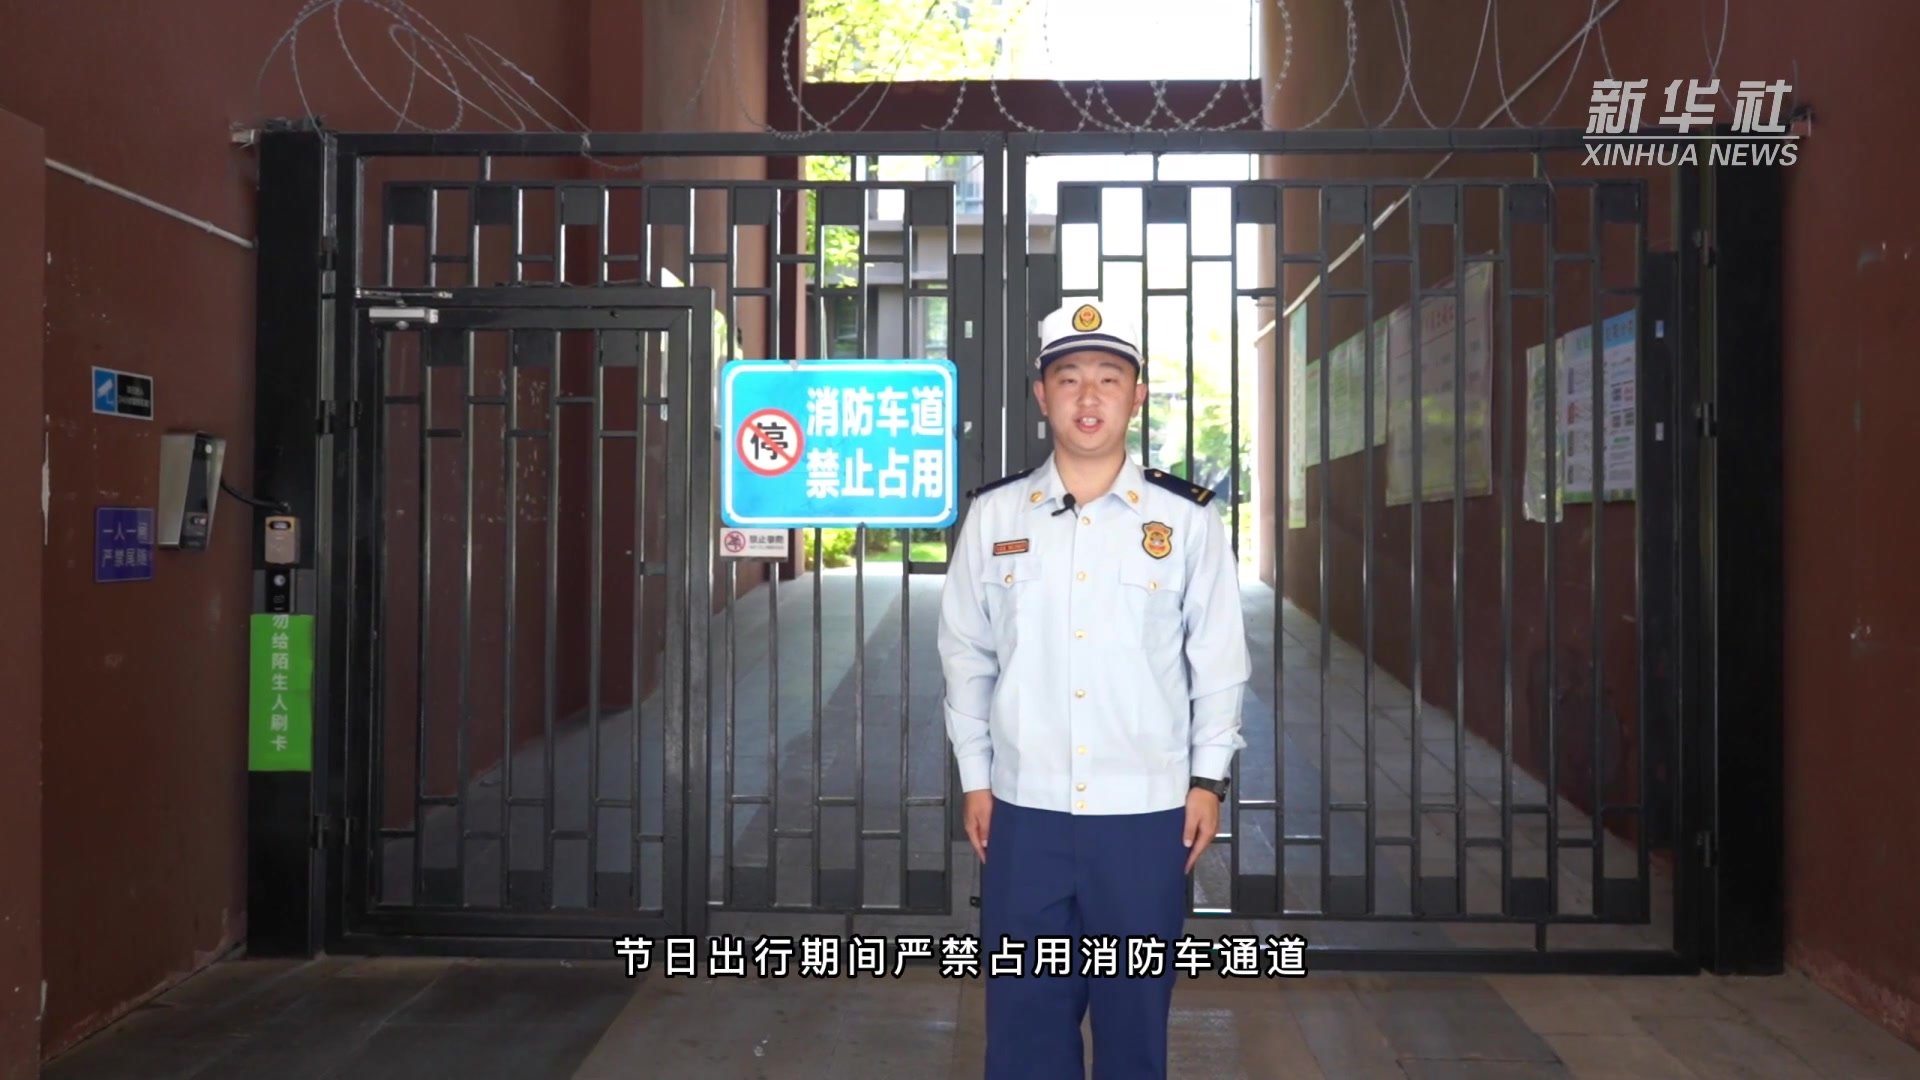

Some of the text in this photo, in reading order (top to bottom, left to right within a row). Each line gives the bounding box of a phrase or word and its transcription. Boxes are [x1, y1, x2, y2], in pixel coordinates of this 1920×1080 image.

[805, 385, 944, 438] 消防车道
[750, 421, 789, 461] 停
[805, 447, 944, 500] 禁止占用
[270, 614, 290, 751] 勿给陌生人刷卡
